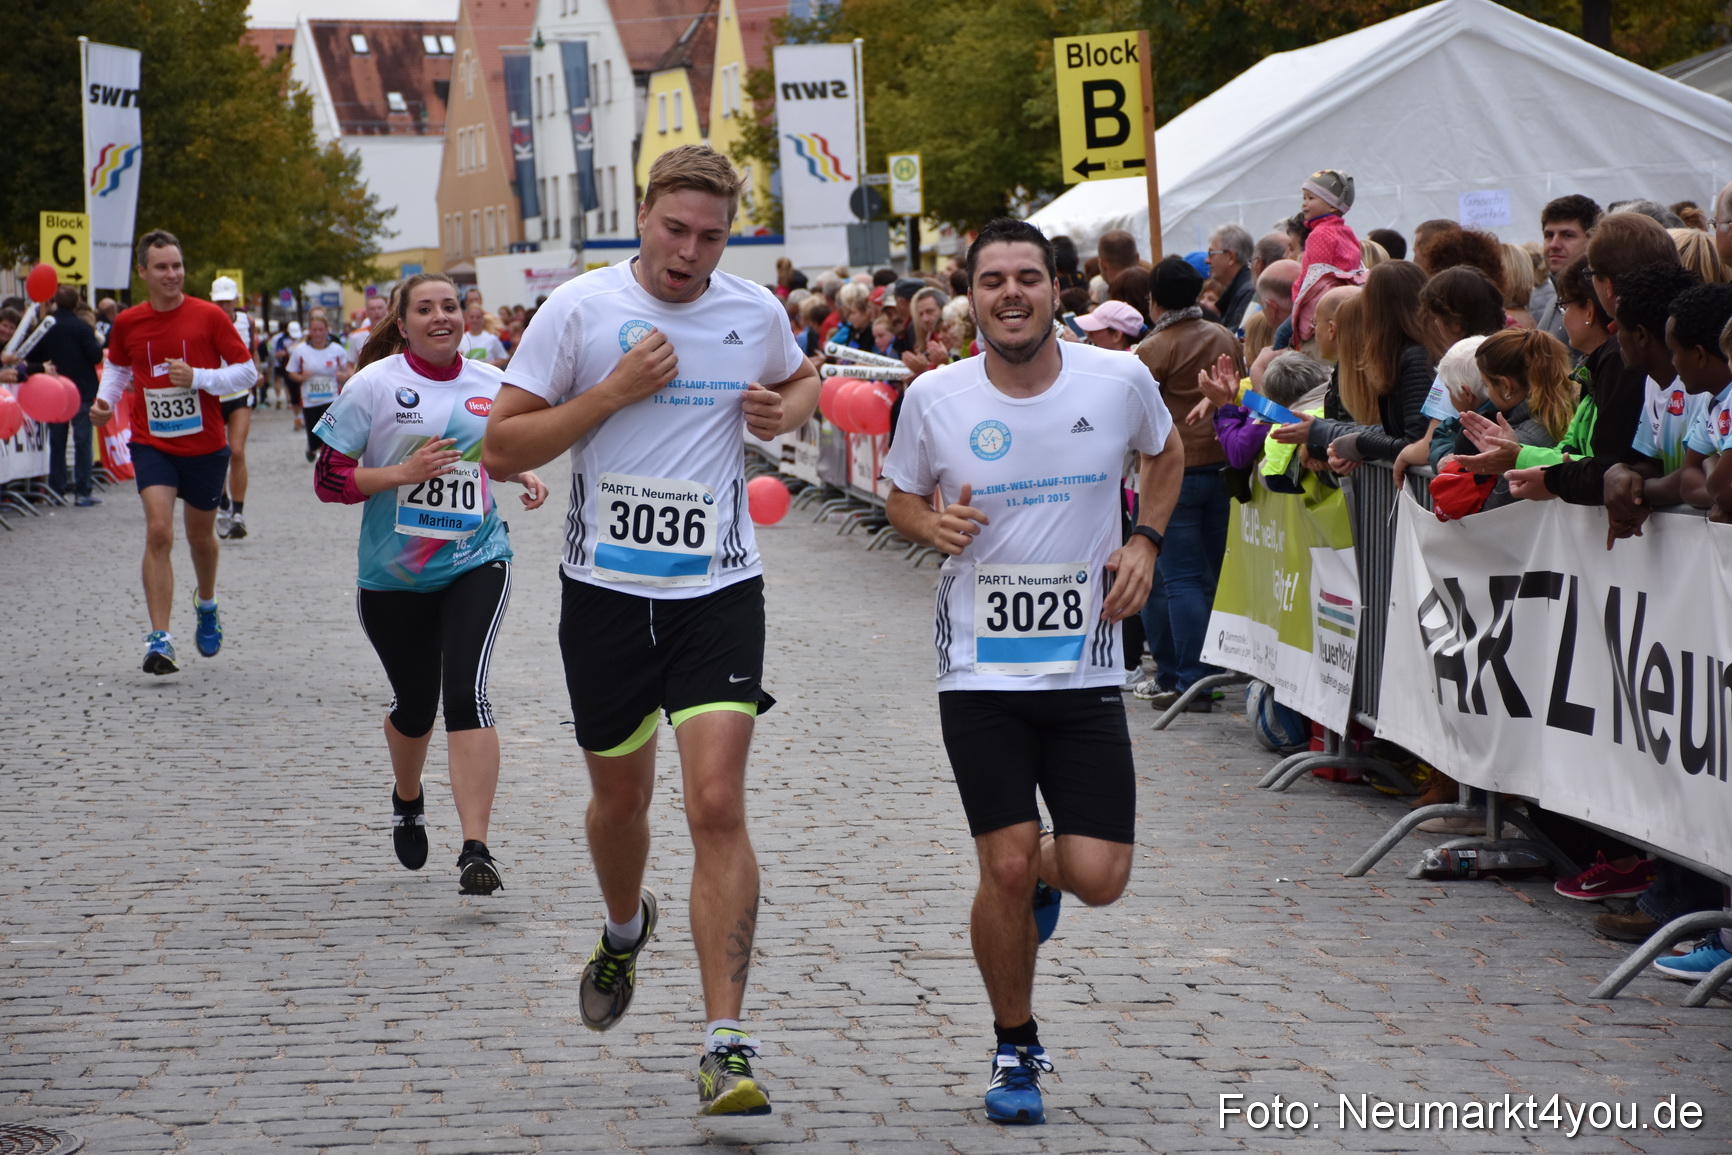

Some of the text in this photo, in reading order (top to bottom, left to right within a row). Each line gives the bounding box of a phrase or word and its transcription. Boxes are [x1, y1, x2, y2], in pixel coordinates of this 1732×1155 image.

[1067, 38, 1139, 69] Block
[90, 83, 140, 108] swn
[1082, 78, 1131, 149] B
[46, 215, 83, 229] Block
[52, 234, 77, 268] C
[843, 369, 868, 378] BMW
[150, 397, 196, 419] 3333
[653, 395, 715, 406] 11. April 2015
[1071, 426, 1094, 434] adidas
[406, 476, 476, 511] 2810
[601, 482, 699, 503] PARTL Neumarkt
[1006, 493, 1070, 507] 11. April 2015
[418, 513, 463, 529] Martina
[609, 499, 706, 549] 3036
[978, 573, 1074, 586] PARTL Neumarkt
[986, 589, 1084, 632] 3028
